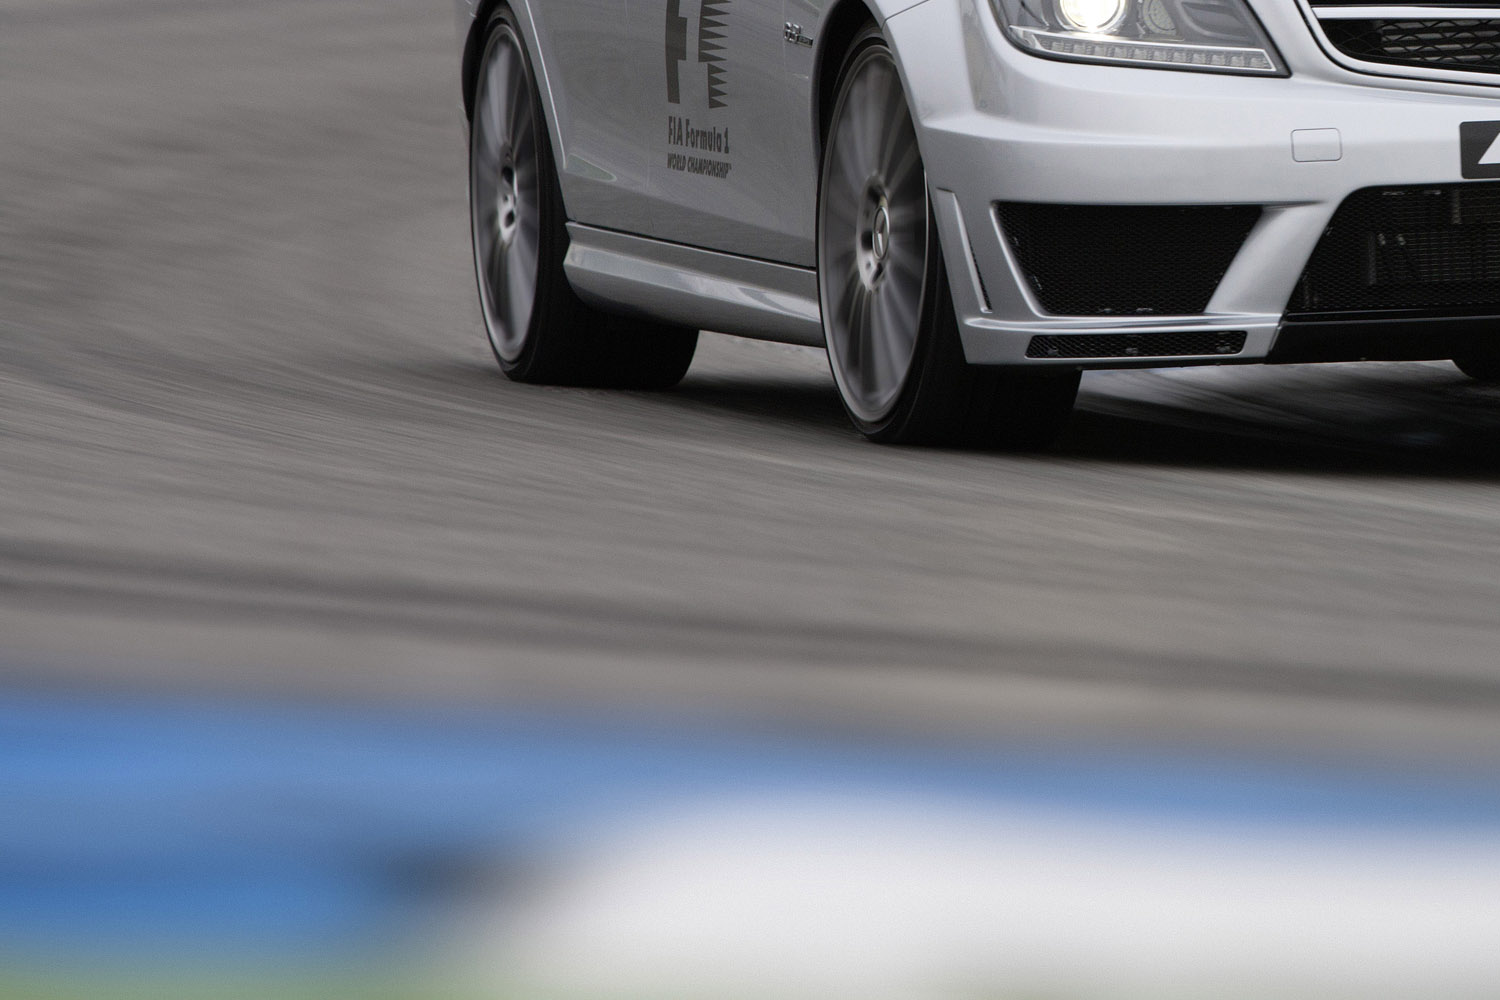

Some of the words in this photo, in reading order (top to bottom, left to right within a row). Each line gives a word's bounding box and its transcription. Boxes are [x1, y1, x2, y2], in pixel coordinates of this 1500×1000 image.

[668, 115, 683, 146] FIA
[685, 118, 722, 153] Formula
[724, 127, 729, 154] 1
[667, 153, 687, 172] WORLD
